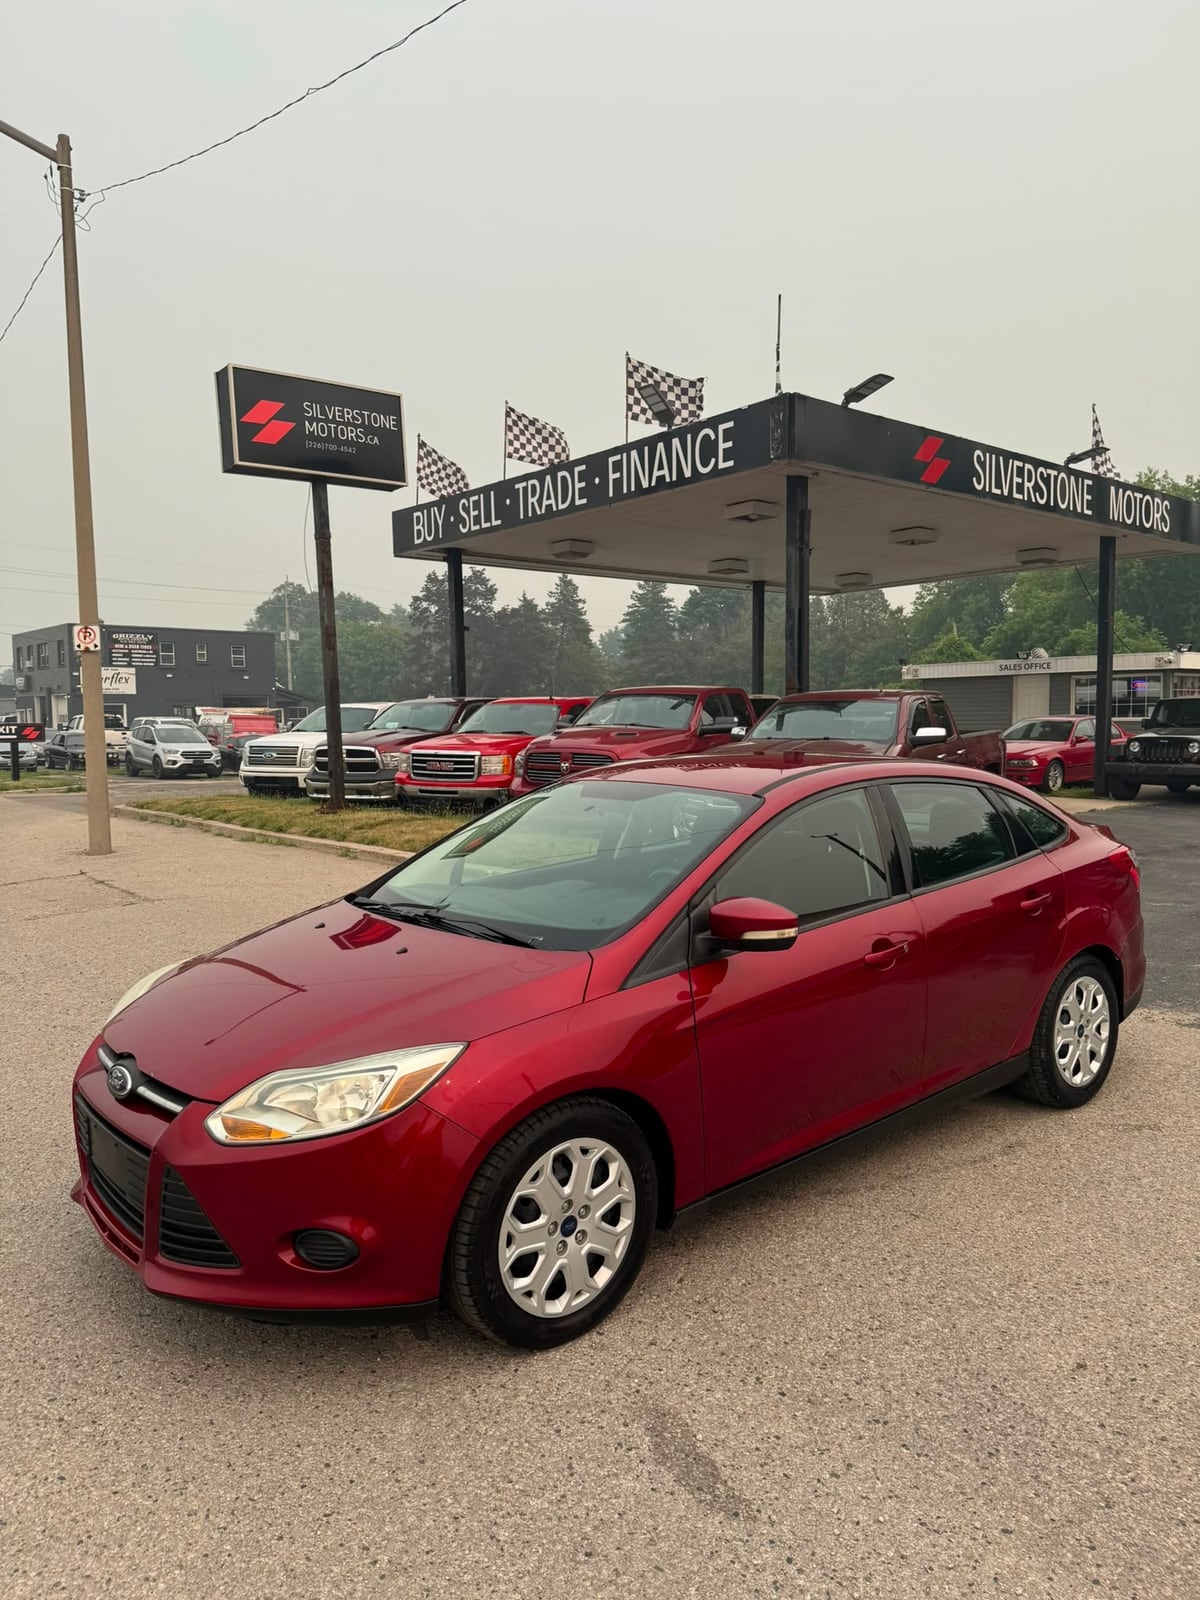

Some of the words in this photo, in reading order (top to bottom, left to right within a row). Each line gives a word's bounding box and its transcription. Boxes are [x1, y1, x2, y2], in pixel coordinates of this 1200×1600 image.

[303, 402, 398, 430] SILVERSTONE
[412, 505, 445, 544] BUY
[458, 491, 502, 534] SELL
[515, 464, 587, 520] TRADE
[608, 420, 734, 498] FINANCE
[972, 450, 1093, 516] SILVERSTONE
[1109, 486, 1170, 534] MOTORS
[999, 664, 1022, 672] SALES
[1024, 662, 1052, 670] OFFICE
[102, 672, 130, 687] rflex
[0, 726, 18, 734] XIT
